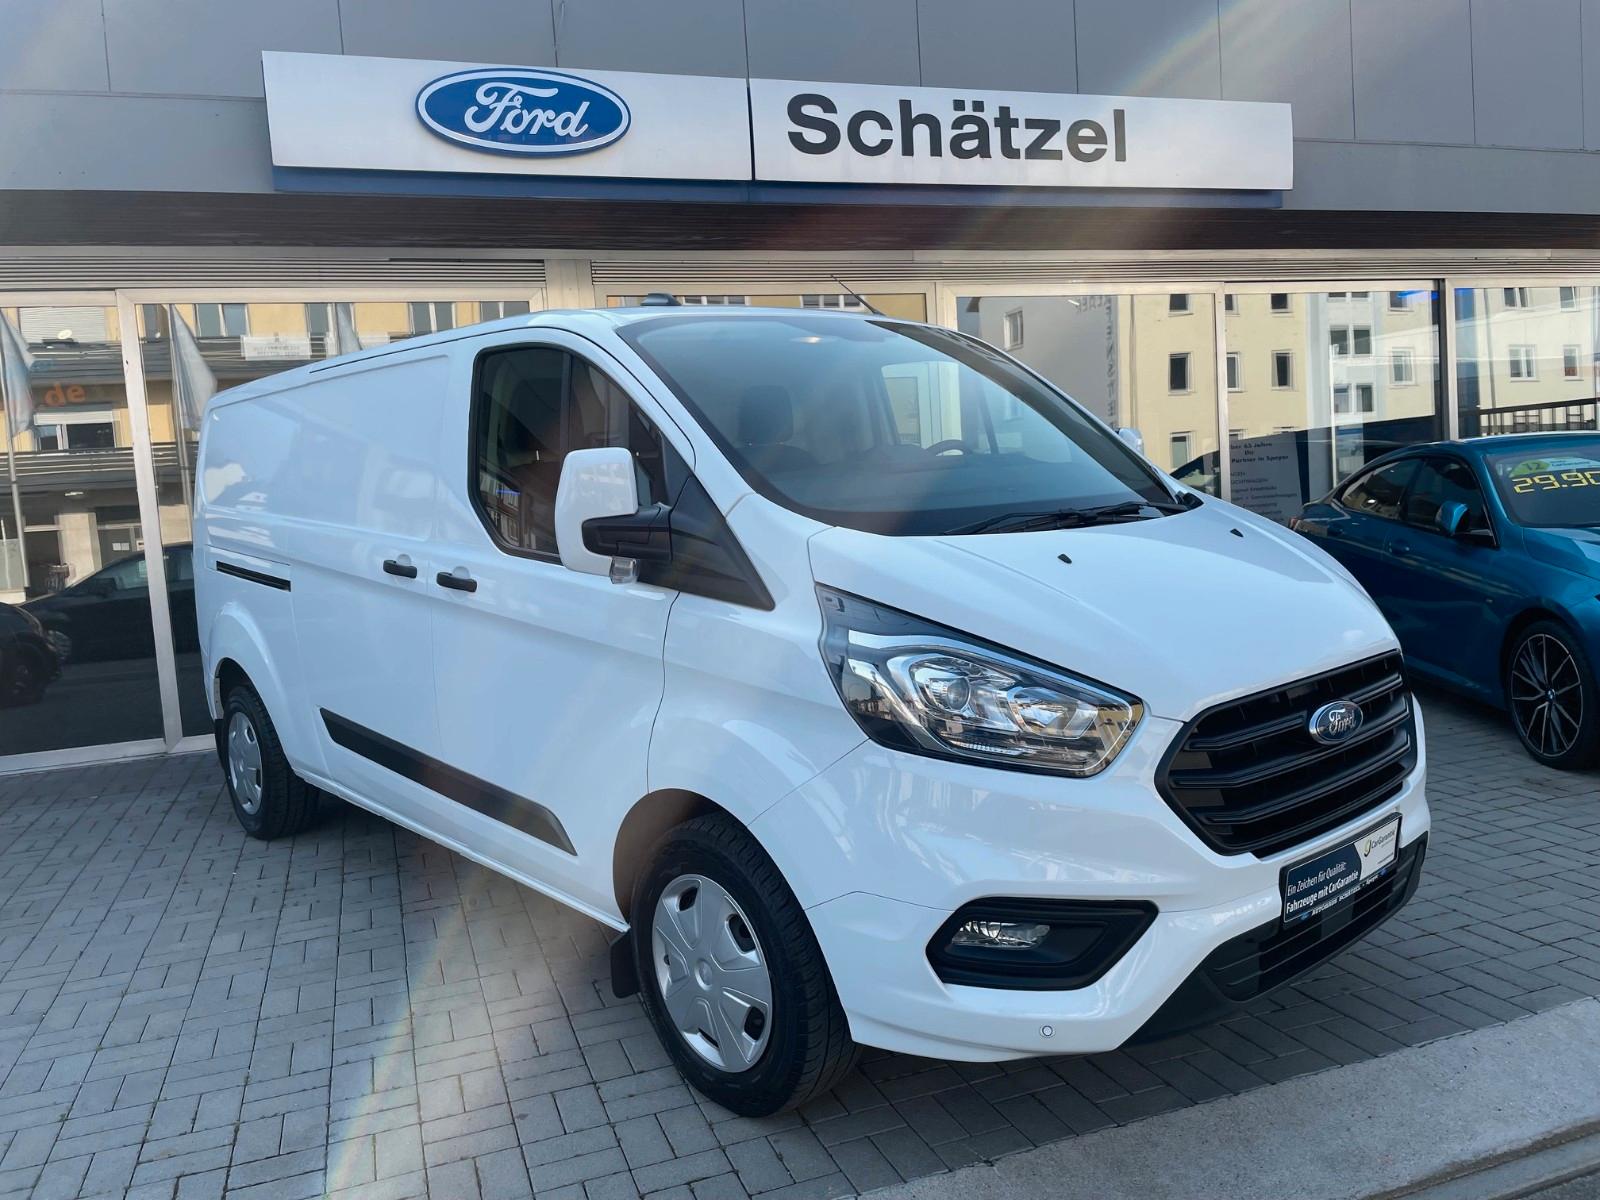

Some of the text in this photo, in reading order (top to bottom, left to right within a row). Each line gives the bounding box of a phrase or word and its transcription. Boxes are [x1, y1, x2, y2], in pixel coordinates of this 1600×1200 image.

[464, 81, 590, 138] Ford
[786, 93, 1127, 163] Schätzel
[1328, 707, 1357, 737] Ford
[1286, 869, 1359, 914] Fahrzeuge mit CarGarantie
[1287, 884, 1297, 897] Ein
[1297, 876, 1318, 893] Zeichen
[1318, 871, 1326, 883] für
